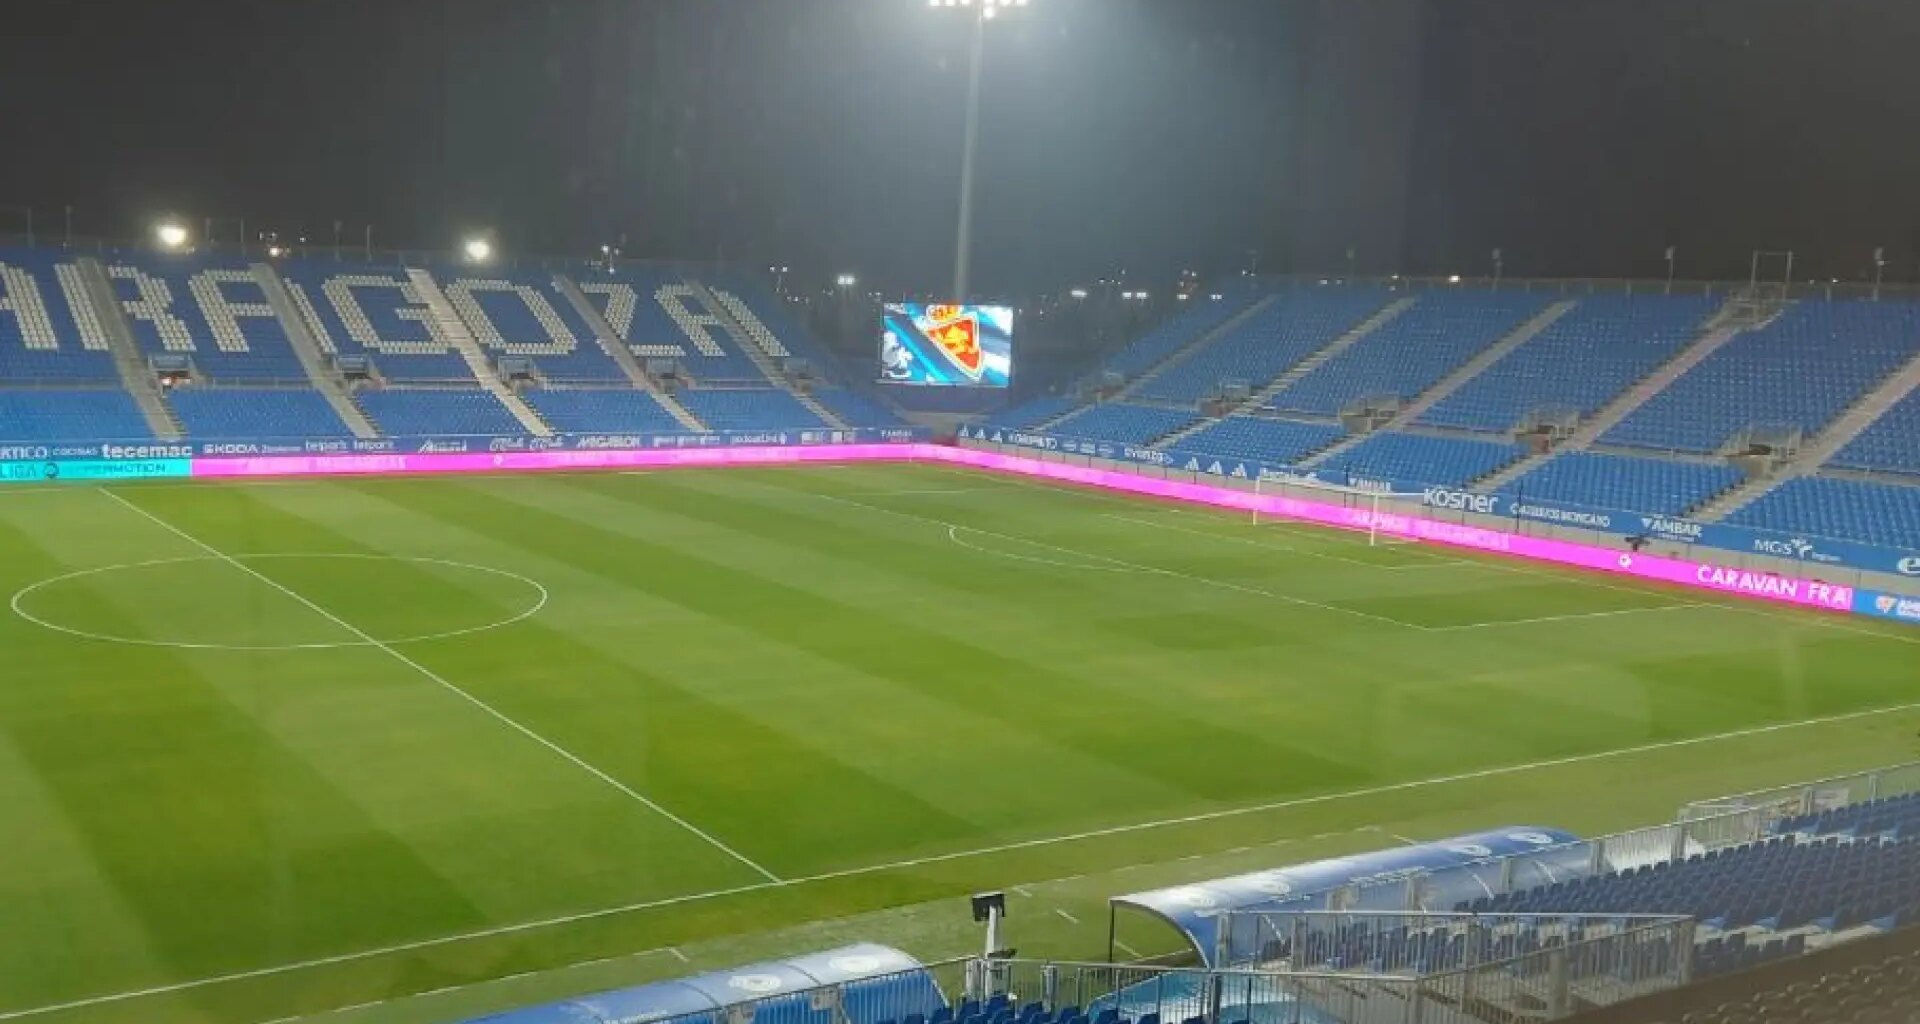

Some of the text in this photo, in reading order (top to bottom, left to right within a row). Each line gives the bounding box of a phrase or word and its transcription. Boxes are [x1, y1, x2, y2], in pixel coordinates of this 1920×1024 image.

[103, 444, 193, 458] tecemac
[1755, 539, 1793, 555] MGS
[1697, 564, 1798, 597] CARAVAN
